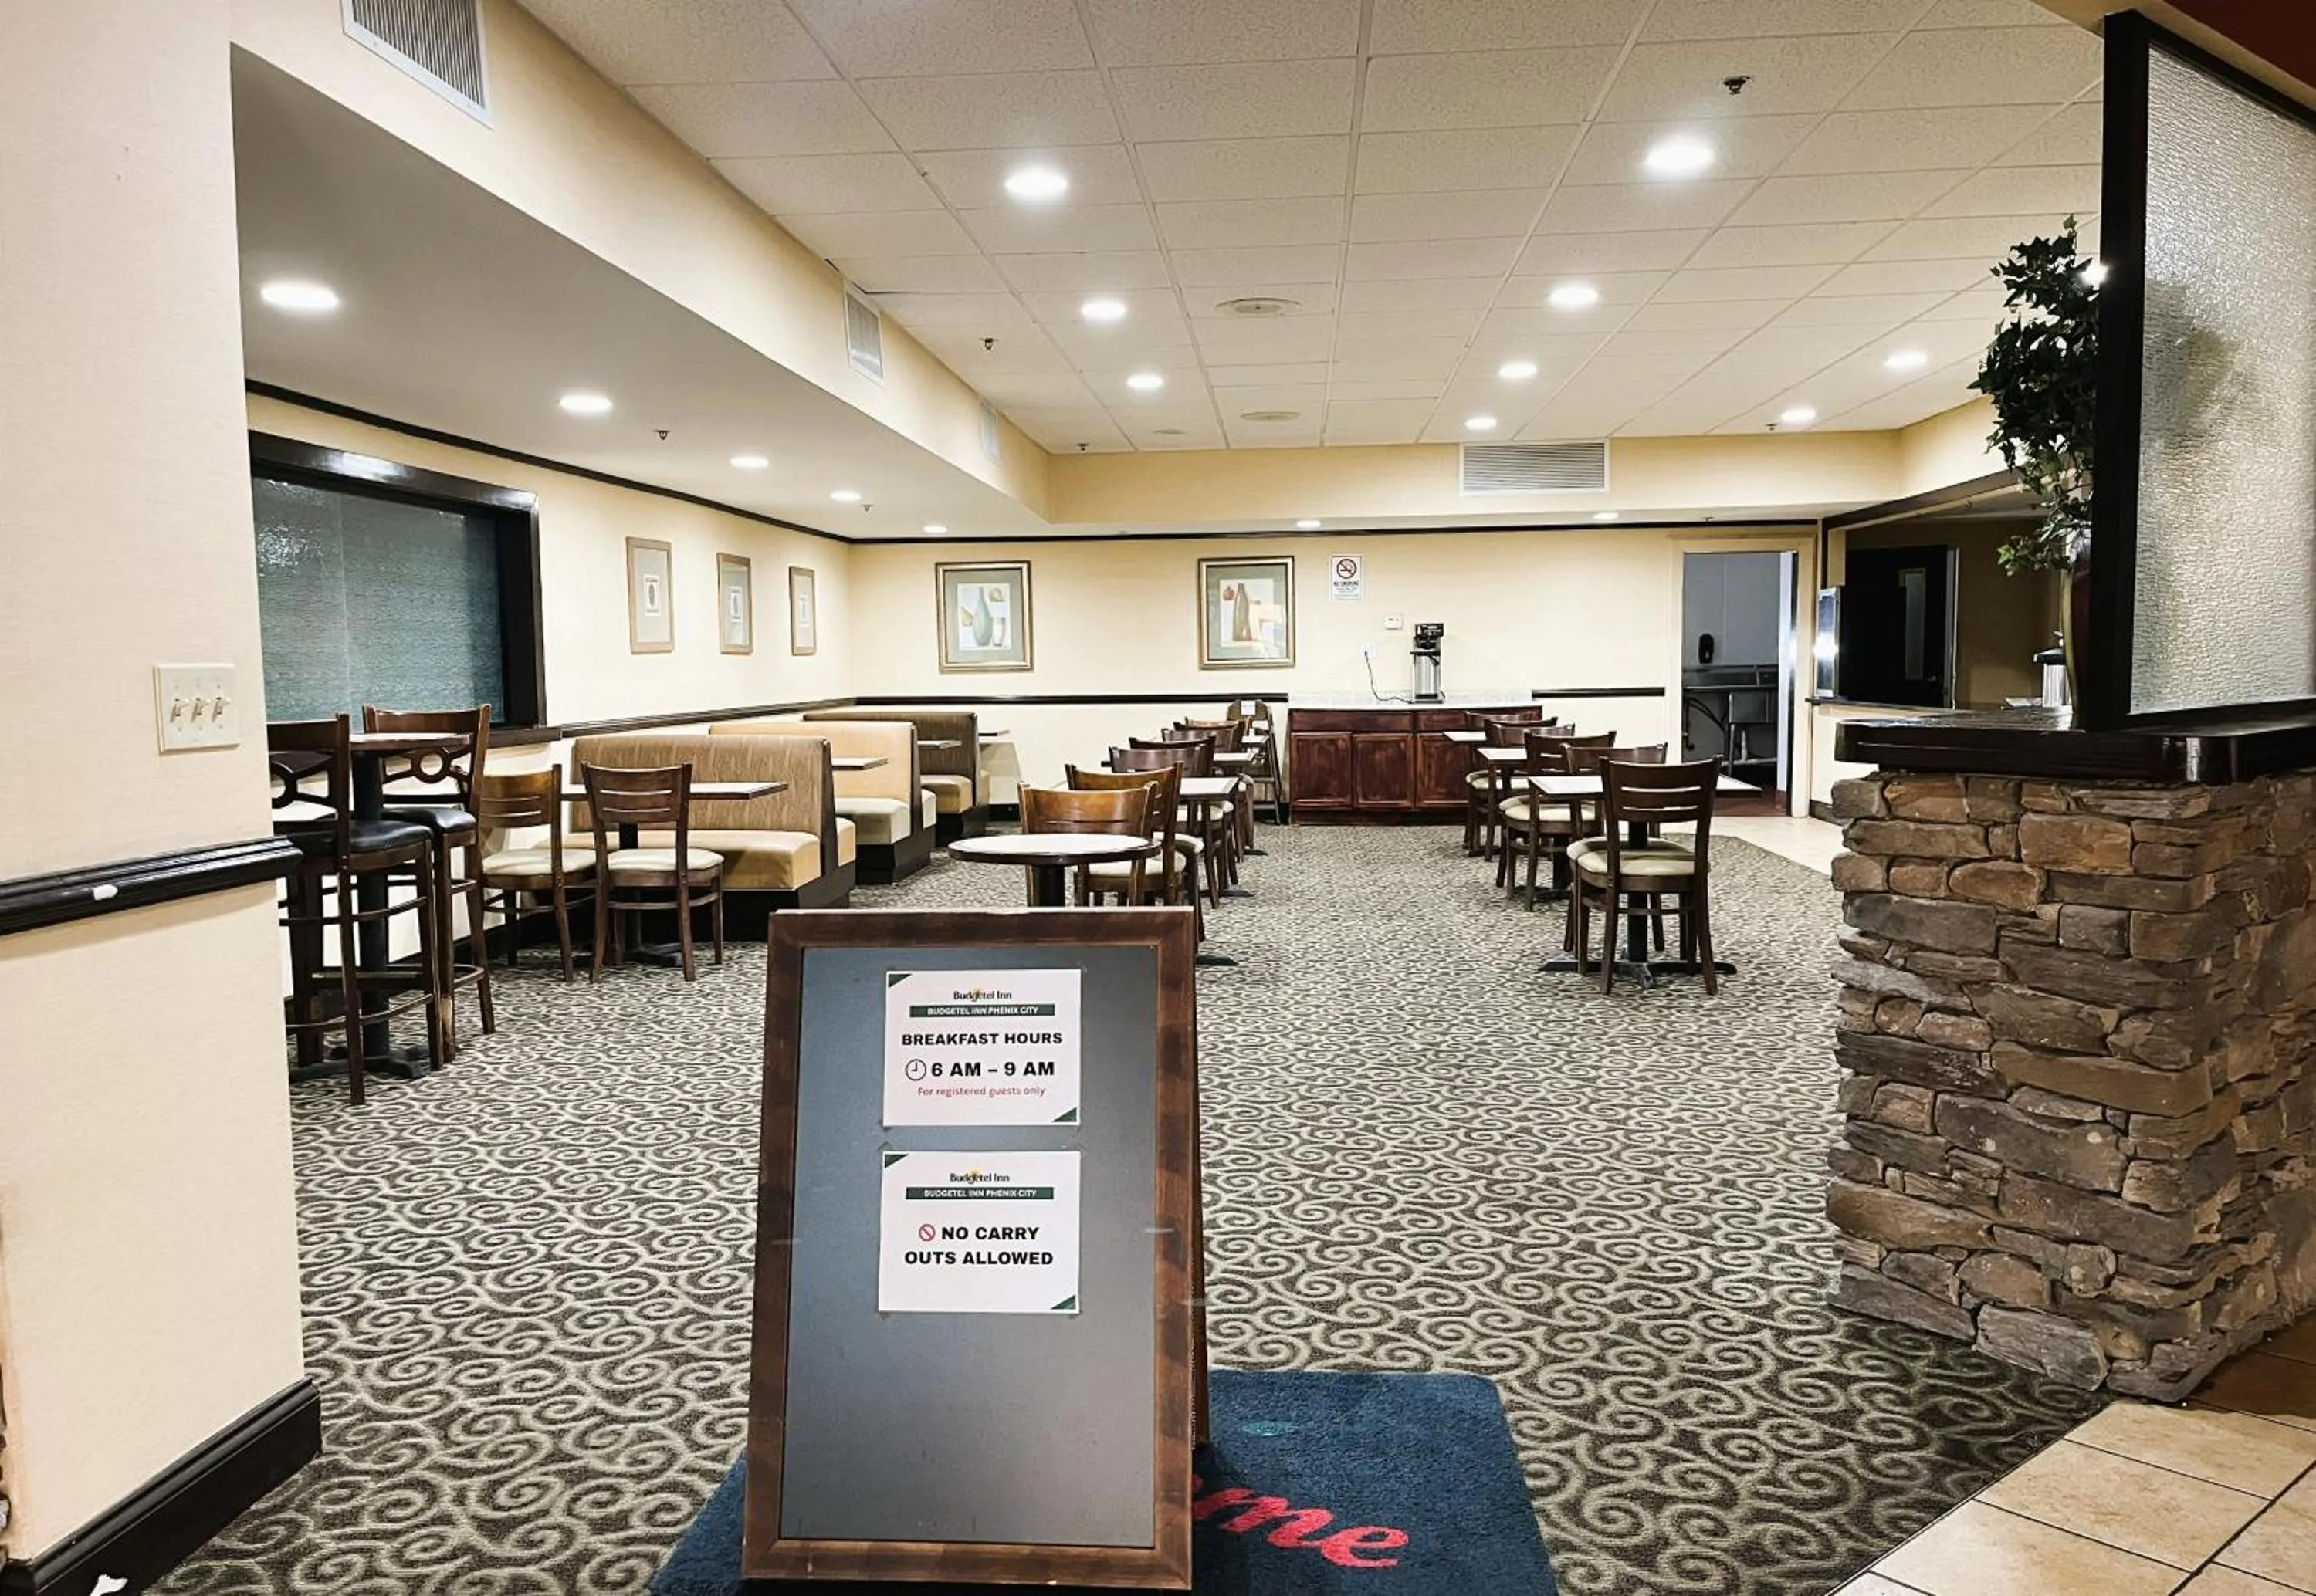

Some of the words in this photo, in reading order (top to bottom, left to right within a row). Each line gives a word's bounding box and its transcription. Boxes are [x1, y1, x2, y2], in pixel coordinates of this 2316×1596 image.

[953, 990, 994, 1002] Budgetel
[997, 990, 1012, 999] Inn
[927, 1006, 970, 1015] BUDGETEL
[971, 1006, 987, 1015] INN
[902, 1033, 999, 1046] BREAKFAST
[1004, 1032, 1063, 1044] HOURS
[931, 1063, 943, 1077] 6
[950, 1062, 981, 1076] AM
[1004, 1062, 1016, 1076] 9
[1023, 1061, 1055, 1076] AM
[917, 1087, 933, 1096] For
[936, 1087, 986, 1097] registered
[989, 1087, 1021, 1097] guests
[1024, 1087, 1045, 1097] only
[950, 1173, 991, 1184] Budgetel
[994, 1173, 1010, 1182] Inn
[941, 1226, 968, 1240] NO
[975, 1226, 1039, 1240] CARRY
[905, 1251, 956, 1264] OUTS
[962, 1251, 1054, 1265] ALLOWED
[1192, 1474, 1409, 1568] me
